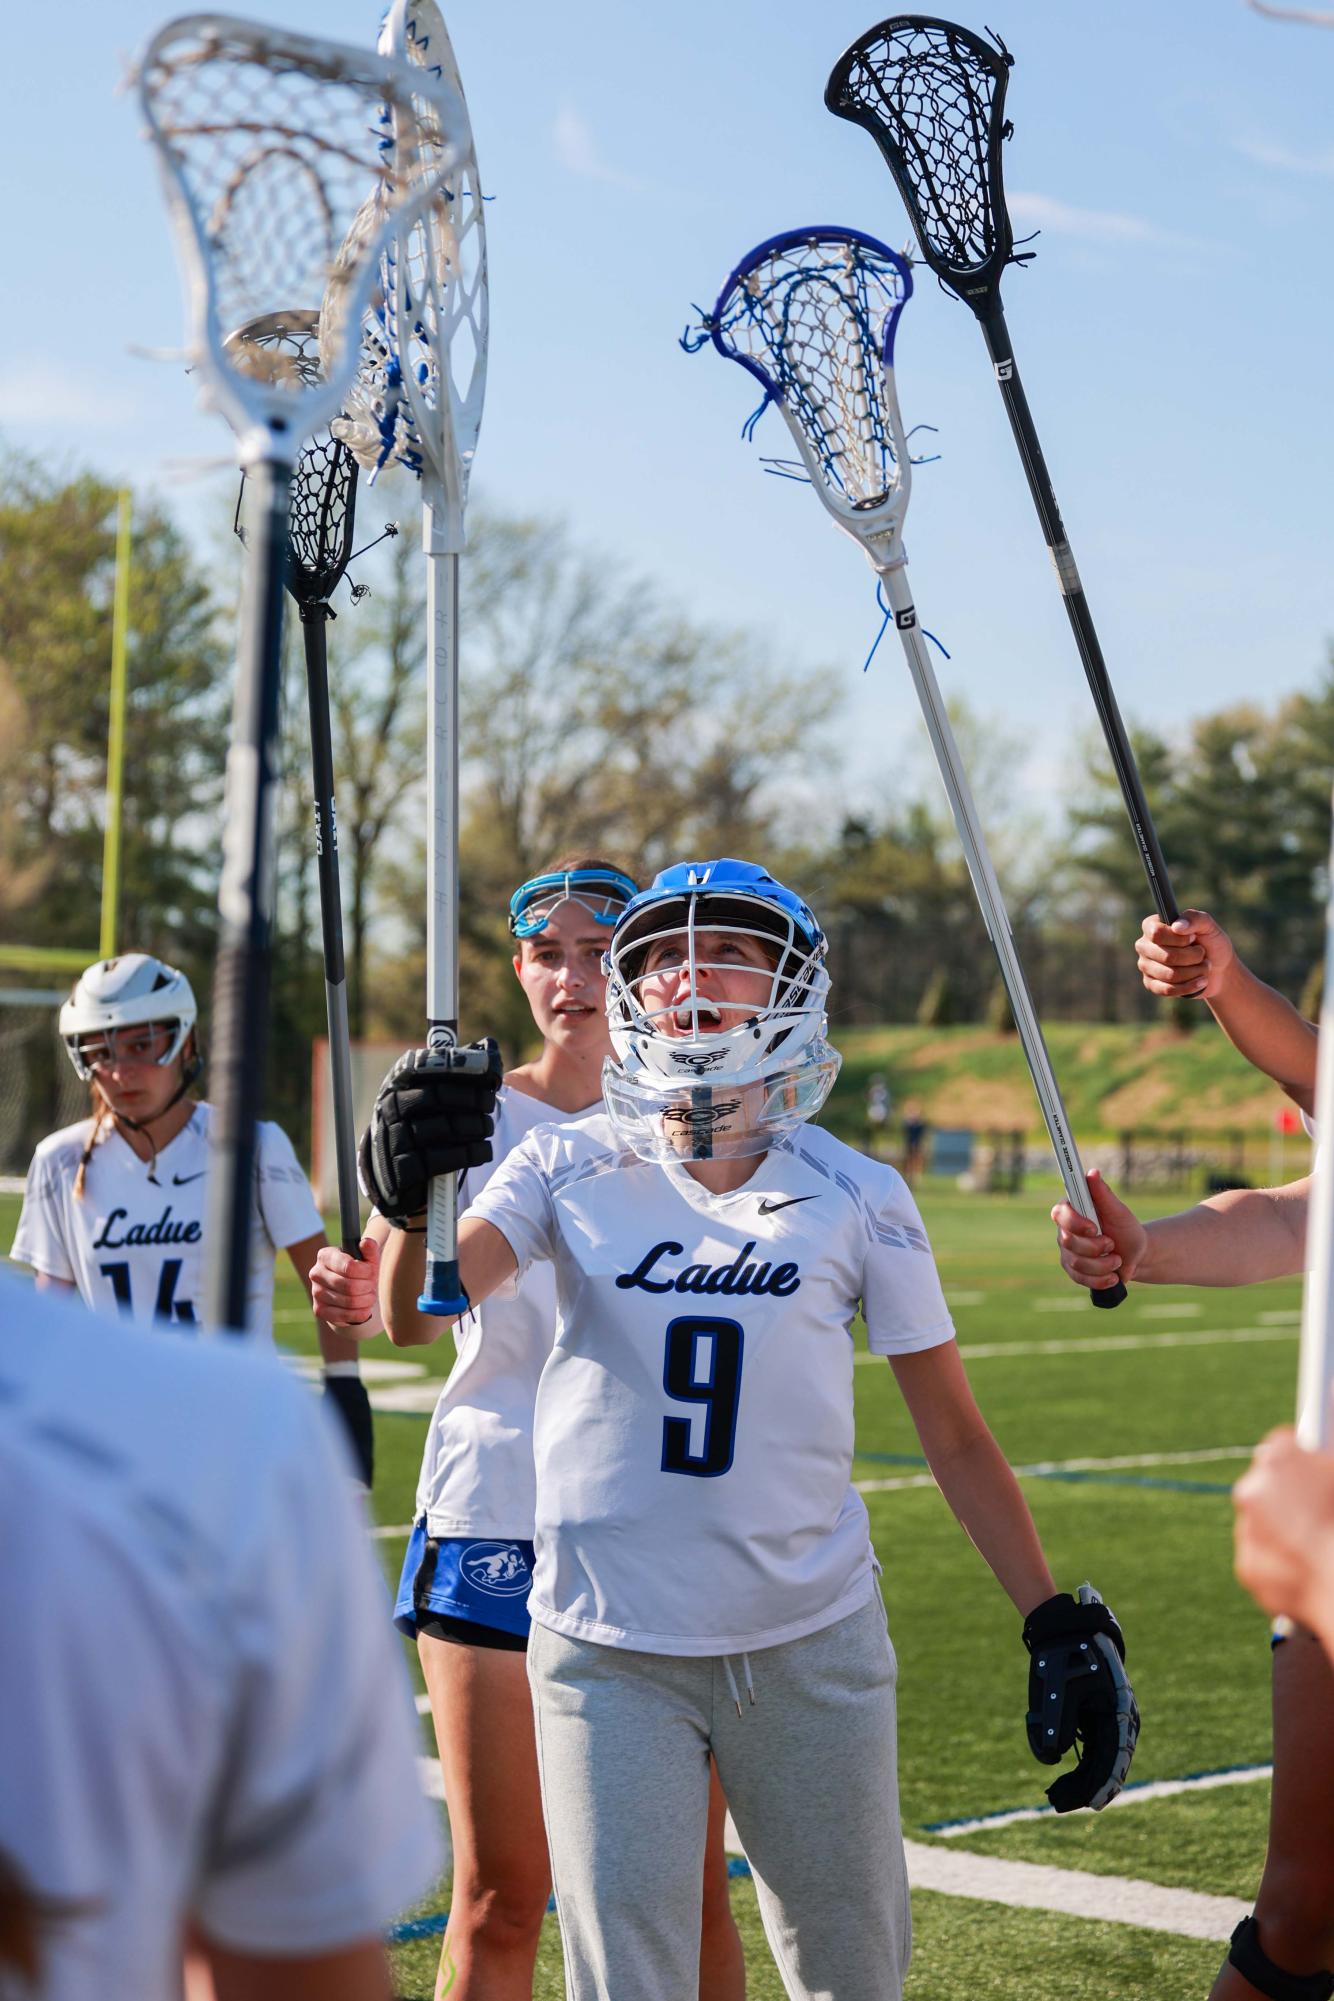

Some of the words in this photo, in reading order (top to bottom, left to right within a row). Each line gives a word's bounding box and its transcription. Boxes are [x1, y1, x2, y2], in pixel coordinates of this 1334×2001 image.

[672, 1125, 732, 1136] cascade
[1052, 1114, 1066, 1145] DIAMETER
[1062, 1147, 1074, 1172] MIDSIZE
[93, 1206, 202, 1249] Ladue
[615, 1241, 801, 1297] Ladue
[661, 1315, 744, 1478] 9
